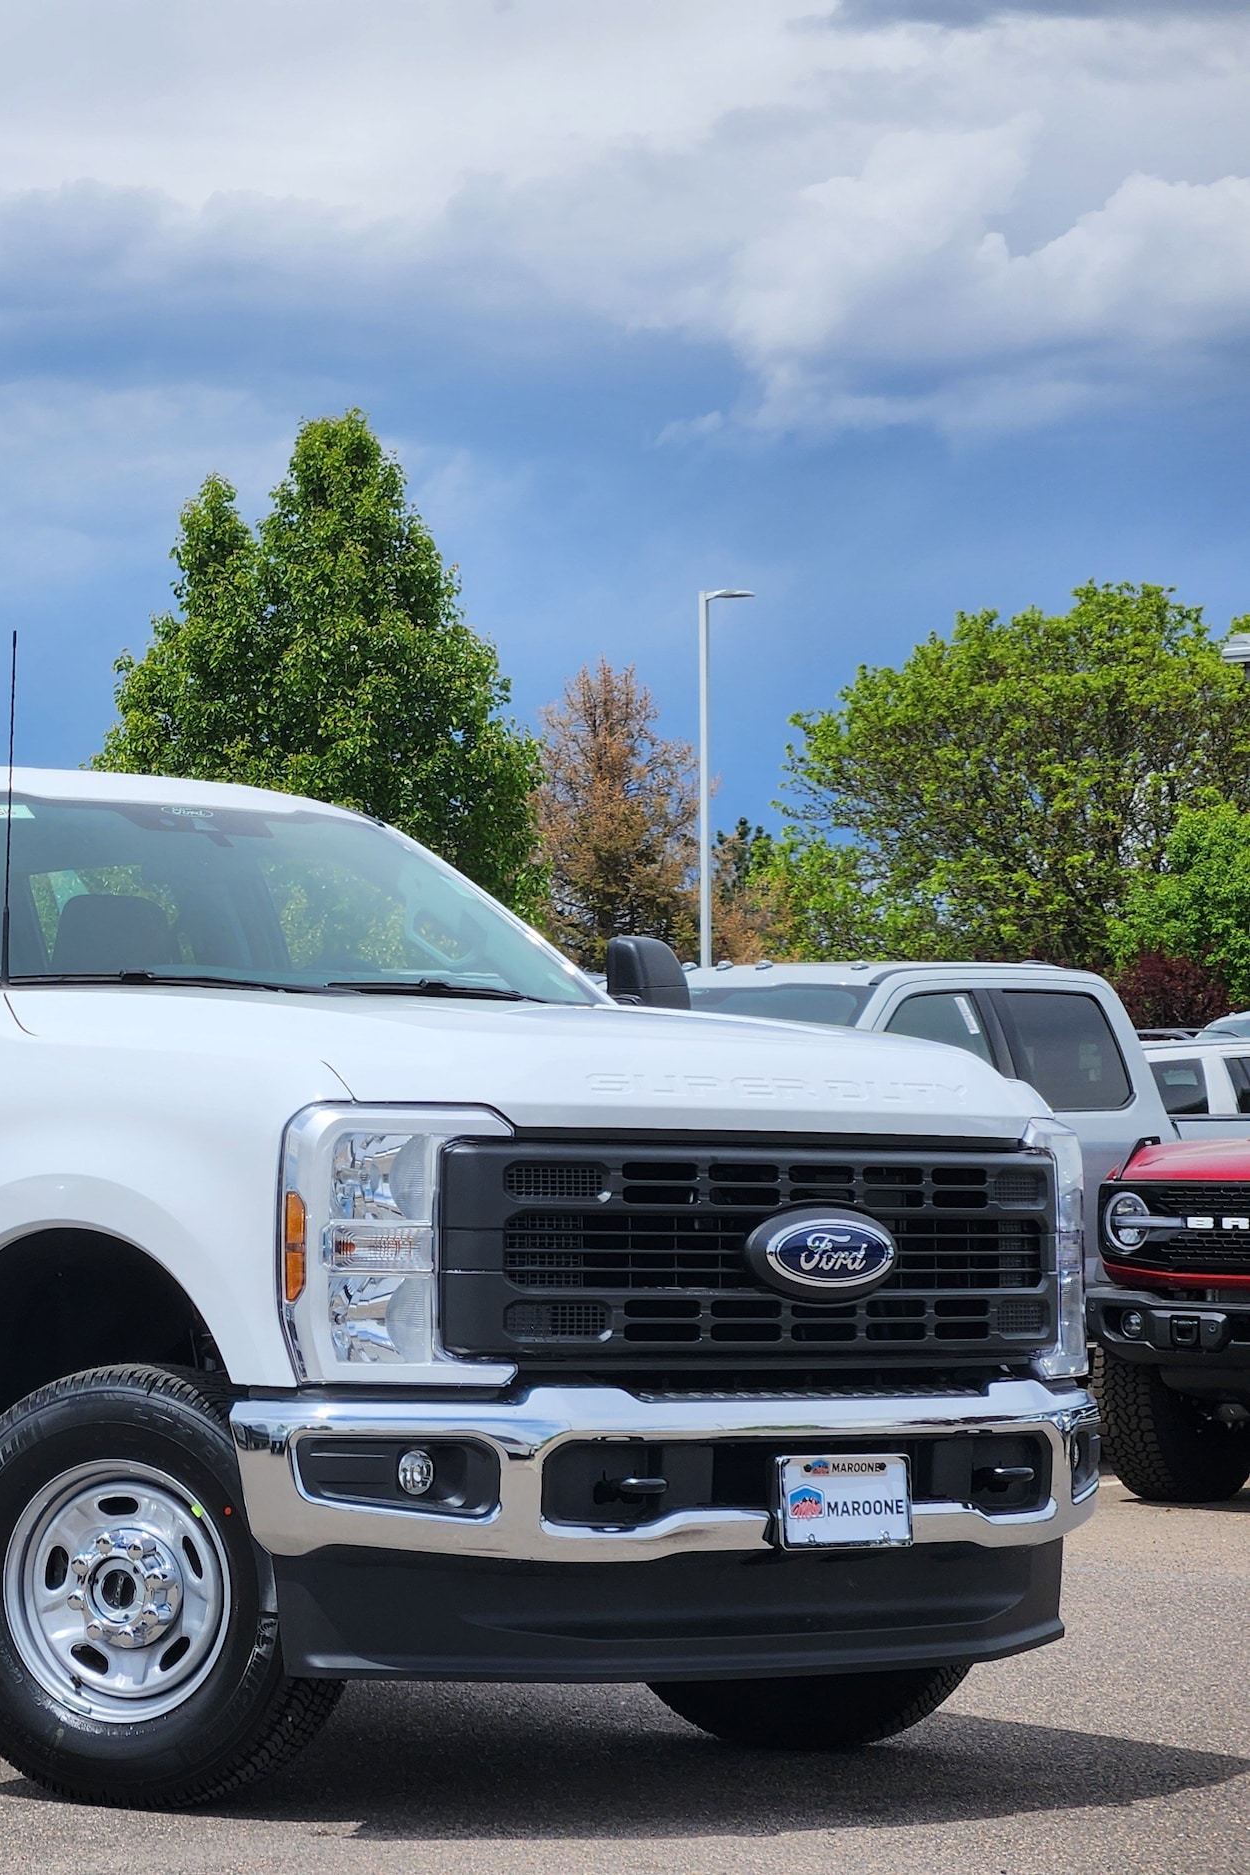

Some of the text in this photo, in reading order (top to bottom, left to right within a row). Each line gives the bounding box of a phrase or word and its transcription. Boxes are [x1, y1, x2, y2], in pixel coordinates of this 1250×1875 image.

[584, 1073, 969, 1105] SUPER DUTY
[800, 1233, 868, 1271] Ford
[831, 1462, 881, 1473] MAROONE
[826, 1499, 905, 1517] MAROONE
